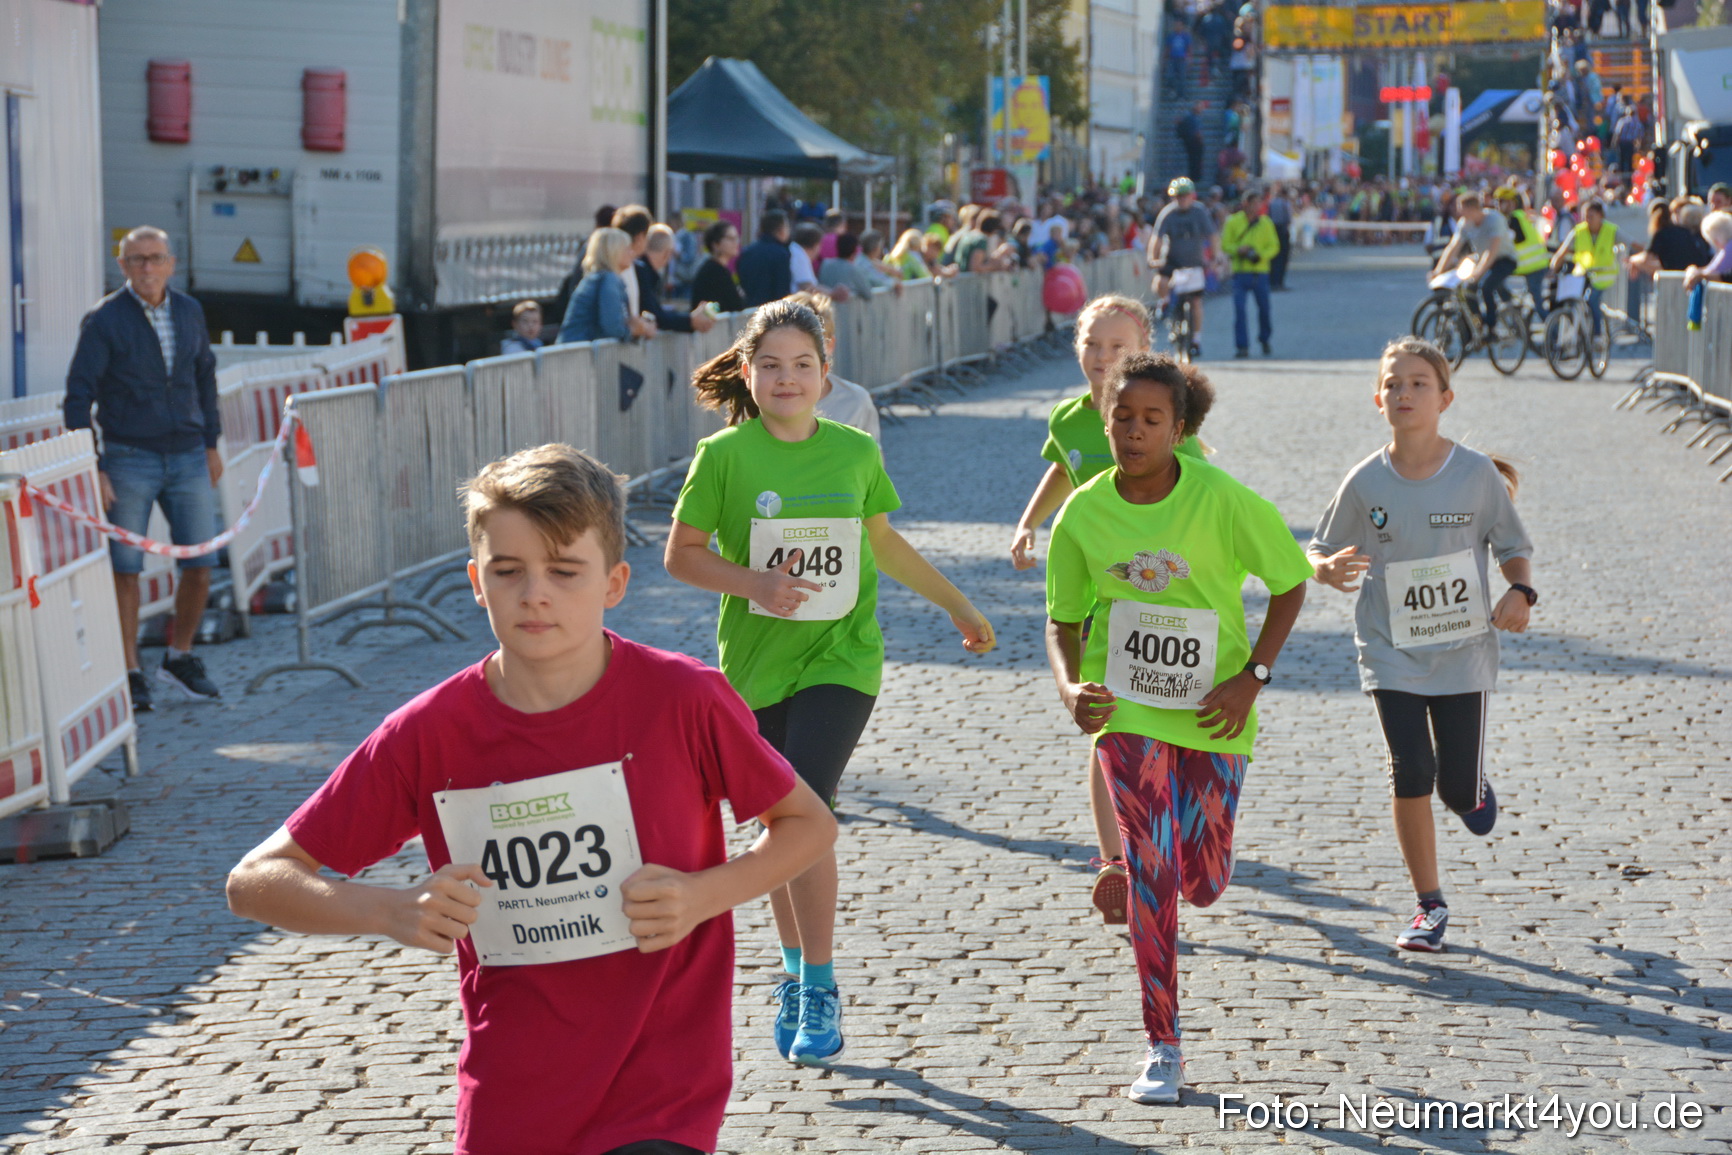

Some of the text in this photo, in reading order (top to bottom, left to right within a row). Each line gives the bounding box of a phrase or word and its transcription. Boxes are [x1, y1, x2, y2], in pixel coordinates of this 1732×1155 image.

[1354, 12, 1452, 36] START
[1429, 511, 1474, 525] BOCK
[783, 527, 829, 539] BOCK
[767, 546, 842, 577] 4048
[1411, 563, 1453, 579] BOCK
[1404, 578, 1469, 611] 4012
[1140, 612, 1187, 628] BOCK
[1410, 619, 1471, 637] Magdalena
[1124, 630, 1200, 668] 4008
[1151, 669, 1183, 679] Neumarkt
[1130, 678, 1188, 698] Thumann
[490, 792, 573, 822] BOCK
[493, 822, 517, 830] inspired
[518, 820, 525, 828] by
[546, 812, 576, 822] concepts
[481, 824, 612, 891] 4023
[498, 890, 590, 910] PARTL Neumarkt
[512, 914, 604, 944] Dominik
